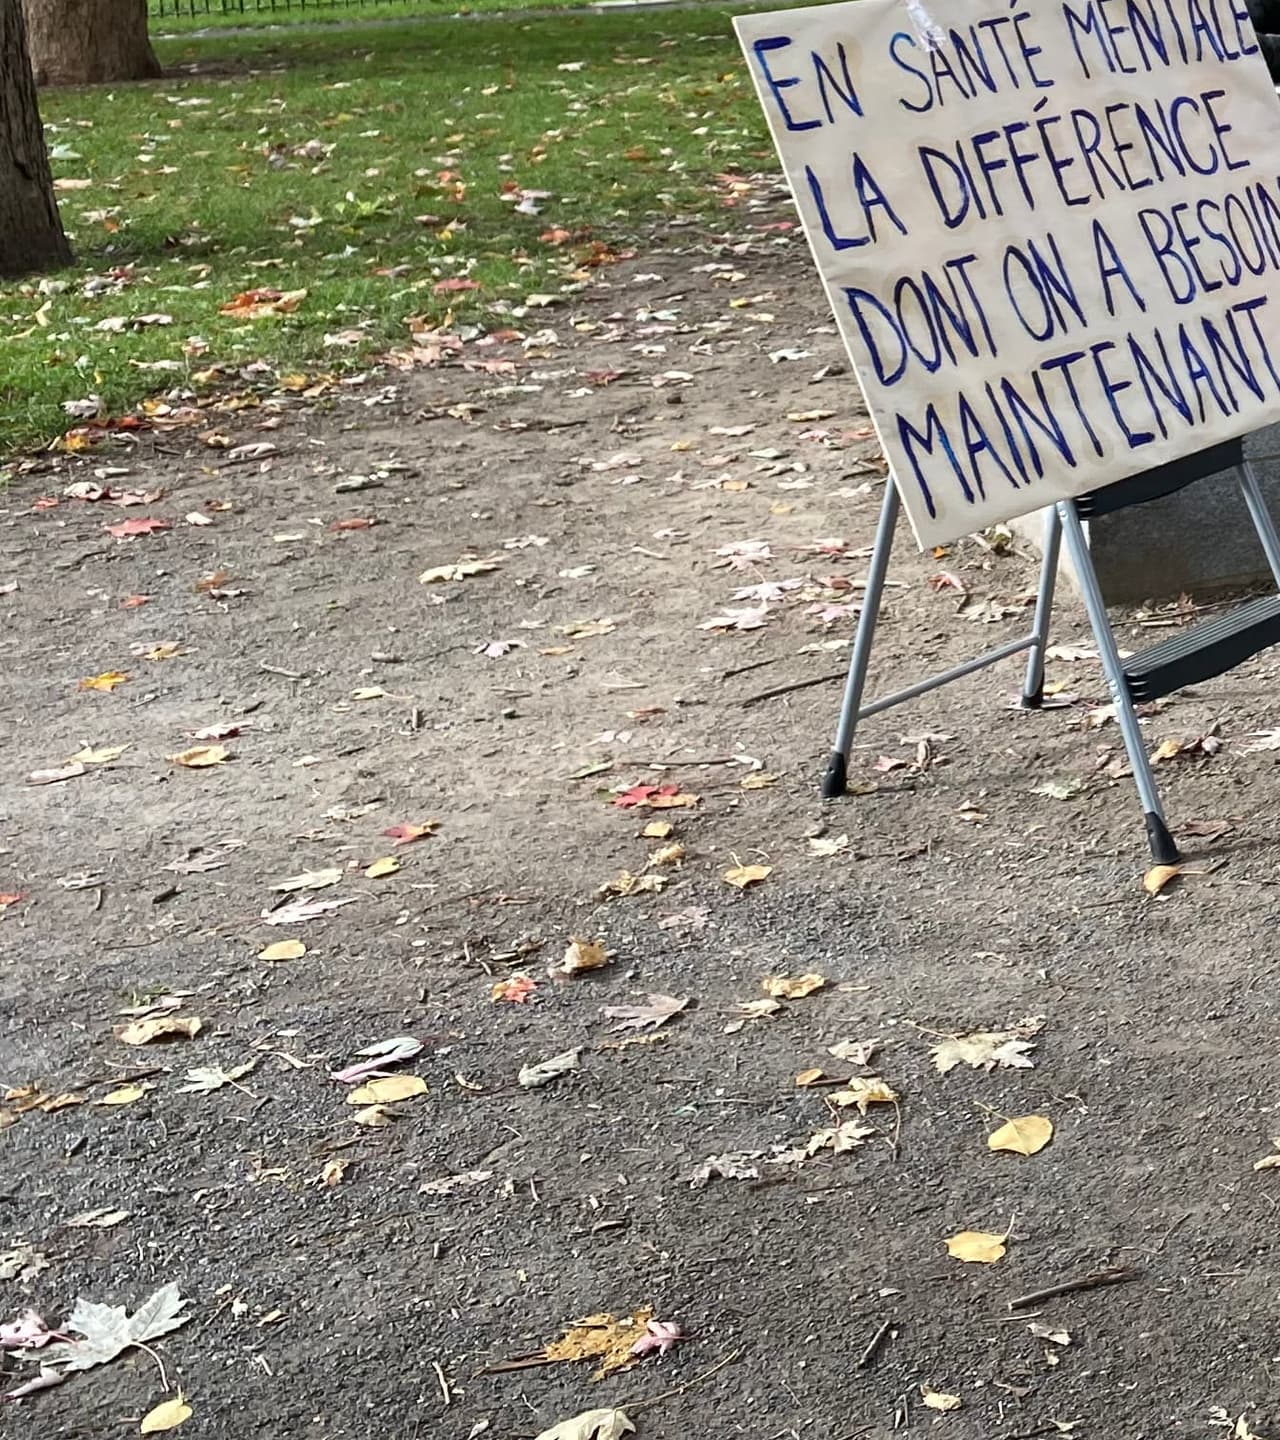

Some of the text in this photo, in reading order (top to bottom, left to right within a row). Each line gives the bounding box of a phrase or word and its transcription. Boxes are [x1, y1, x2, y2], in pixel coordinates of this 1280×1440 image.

[752, 35, 864, 132] EN
[804, 88, 1251, 252] LA DIFFÉRENCE
[845, 254, 998, 388] DONT
[1001, 231, 1088, 343] ON
[1090, 217, 1147, 317] A
